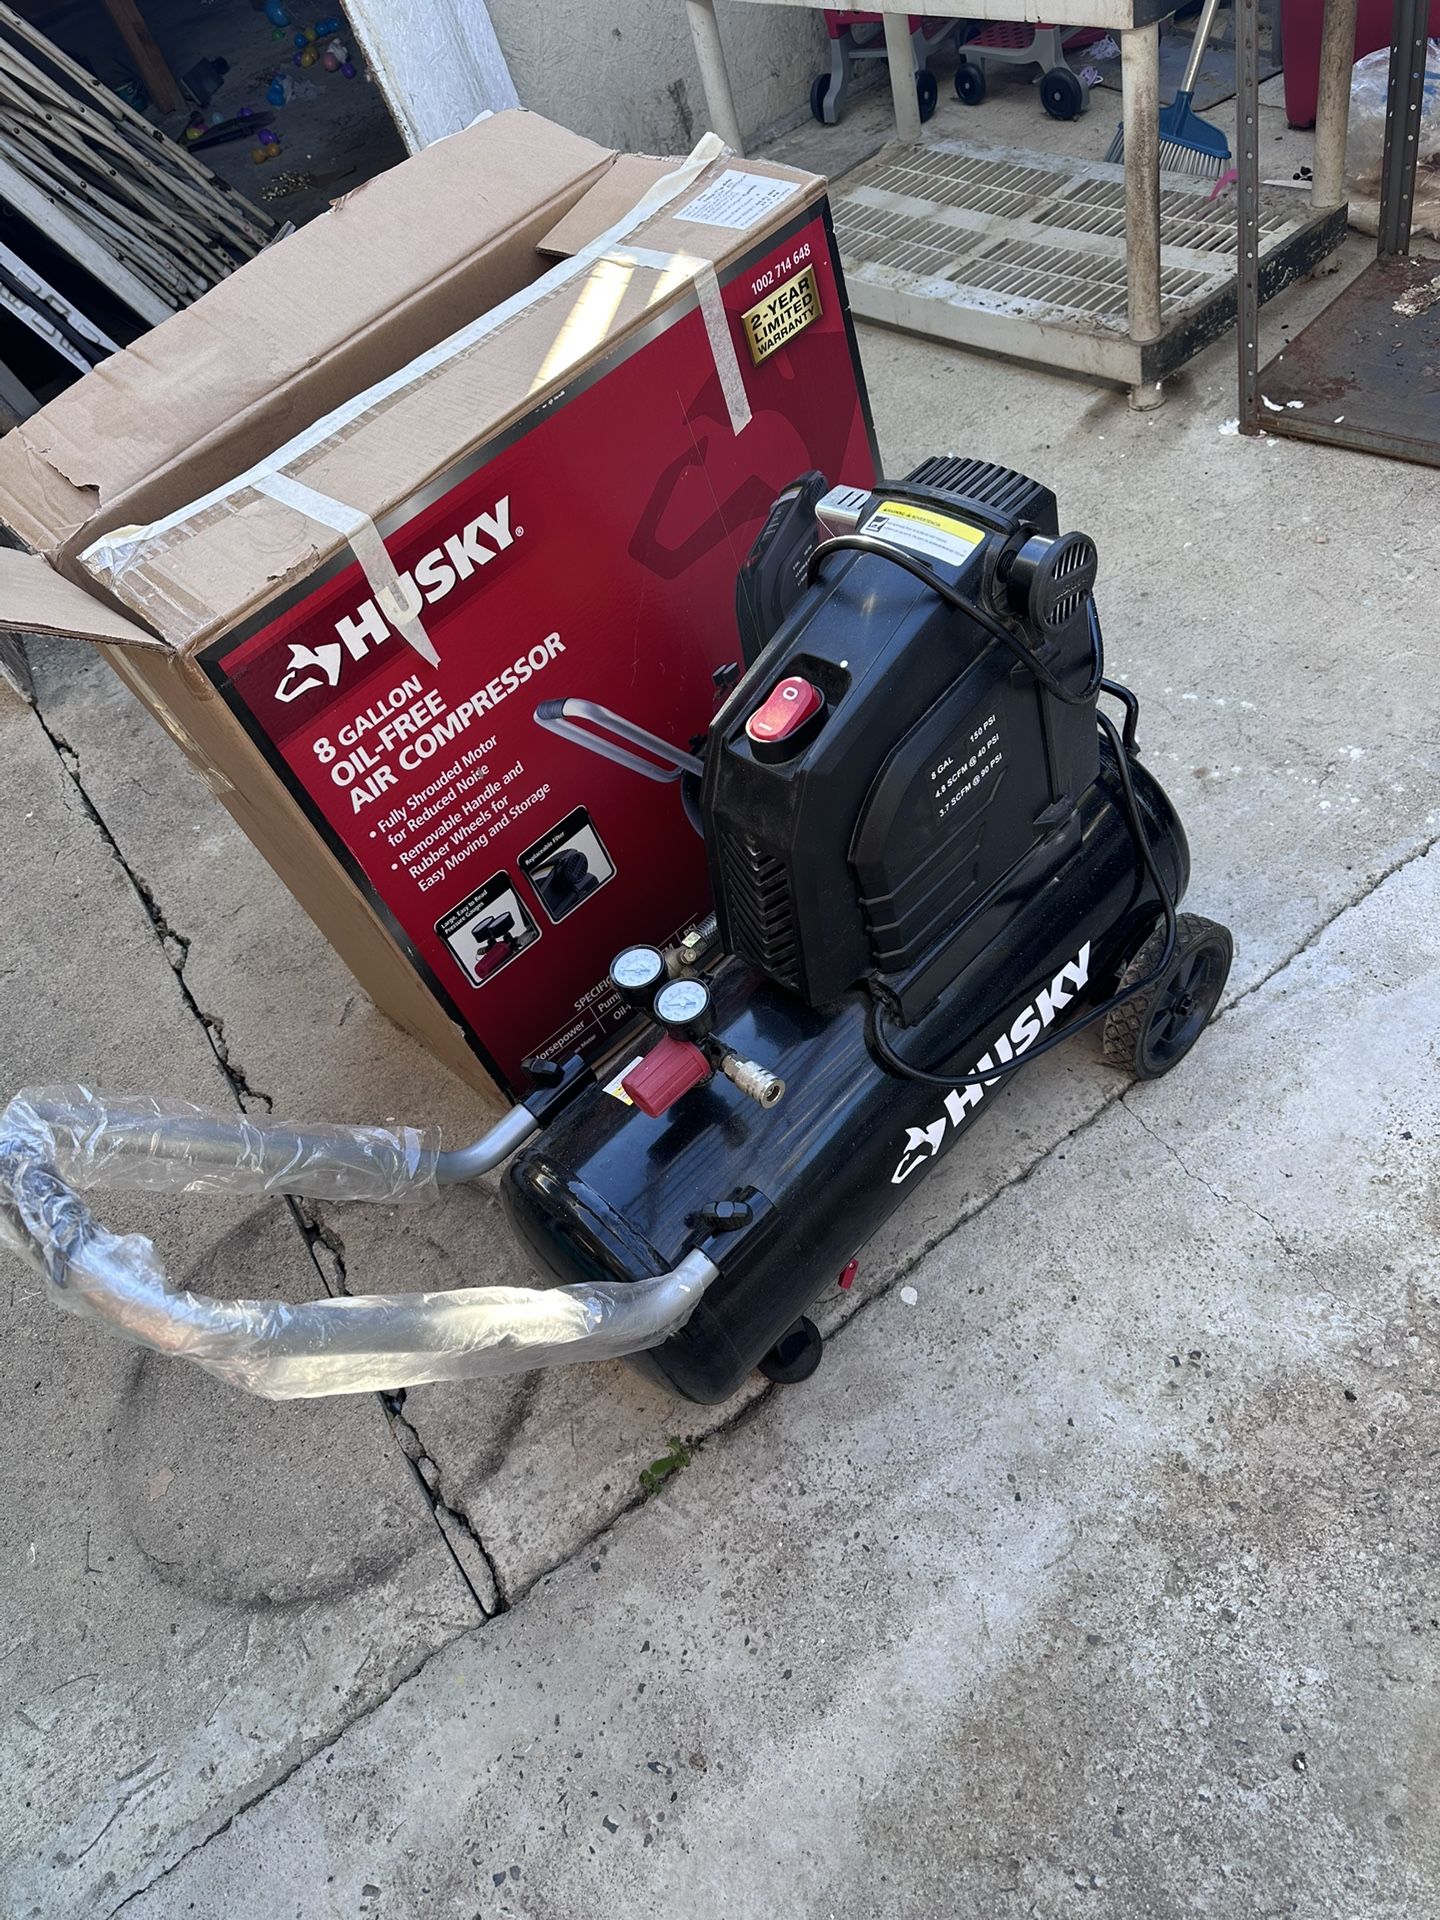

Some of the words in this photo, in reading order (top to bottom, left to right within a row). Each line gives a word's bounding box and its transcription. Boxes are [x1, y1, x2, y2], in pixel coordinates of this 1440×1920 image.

[751, 277, 810, 330] 2-YEAR
[752, 271, 774, 294] 1002
[775, 257, 791, 278] 714
[793, 244, 810, 264] 648
[754, 293, 812, 344] LIMITED
[758, 306, 814, 354] WARRANTY
[334, 495, 514, 661] HUSKY
[313, 738, 336, 763] 8
[338, 675, 422, 745] GALLON
[331, 689, 446, 786] OIL-FREE
[350, 766, 398, 814] AIR
[399, 632, 566, 770] COMPRESSOR
[938, 757, 953, 773] GAL
[970, 727, 982, 742] 150
[984, 715, 995, 730] PSI
[378, 807, 407, 832] Fully
[407, 761, 462, 810] Shrouded
[462, 736, 496, 767] Motor
[936, 785, 946, 797] 4.8
[947, 764, 968, 786] SCFM
[978, 746, 986, 757] 40
[987, 734, 999, 748] PSI
[940, 803, 949, 816] 3.7
[951, 783, 971, 806] SCFM
[981, 766, 989, 777] 90
[990, 753, 1002, 768] PSI
[388, 829, 406, 846] for
[407, 787, 456, 832] Reduced
[456, 765, 489, 793] Noise
[399, 814, 462, 864] Removable
[462, 782, 501, 815] Handle
[503, 761, 524, 784] and
[409, 842, 450, 878] Rubber
[450, 810, 491, 844] Wheels
[491, 796, 508, 813] for
[418, 868, 445, 892] Easy
[445, 834, 488, 870] Moving
[488, 814, 510, 836] and
[509, 784, 550, 819] Storage
[552, 832, 564, 843] Filter
[445, 916, 465, 934] Pressure
[465, 902, 484, 917] Gauges
[456, 906, 468, 916] Easy
[474, 890, 487, 902] Read
[944, 940, 1090, 1127] HUSKY
